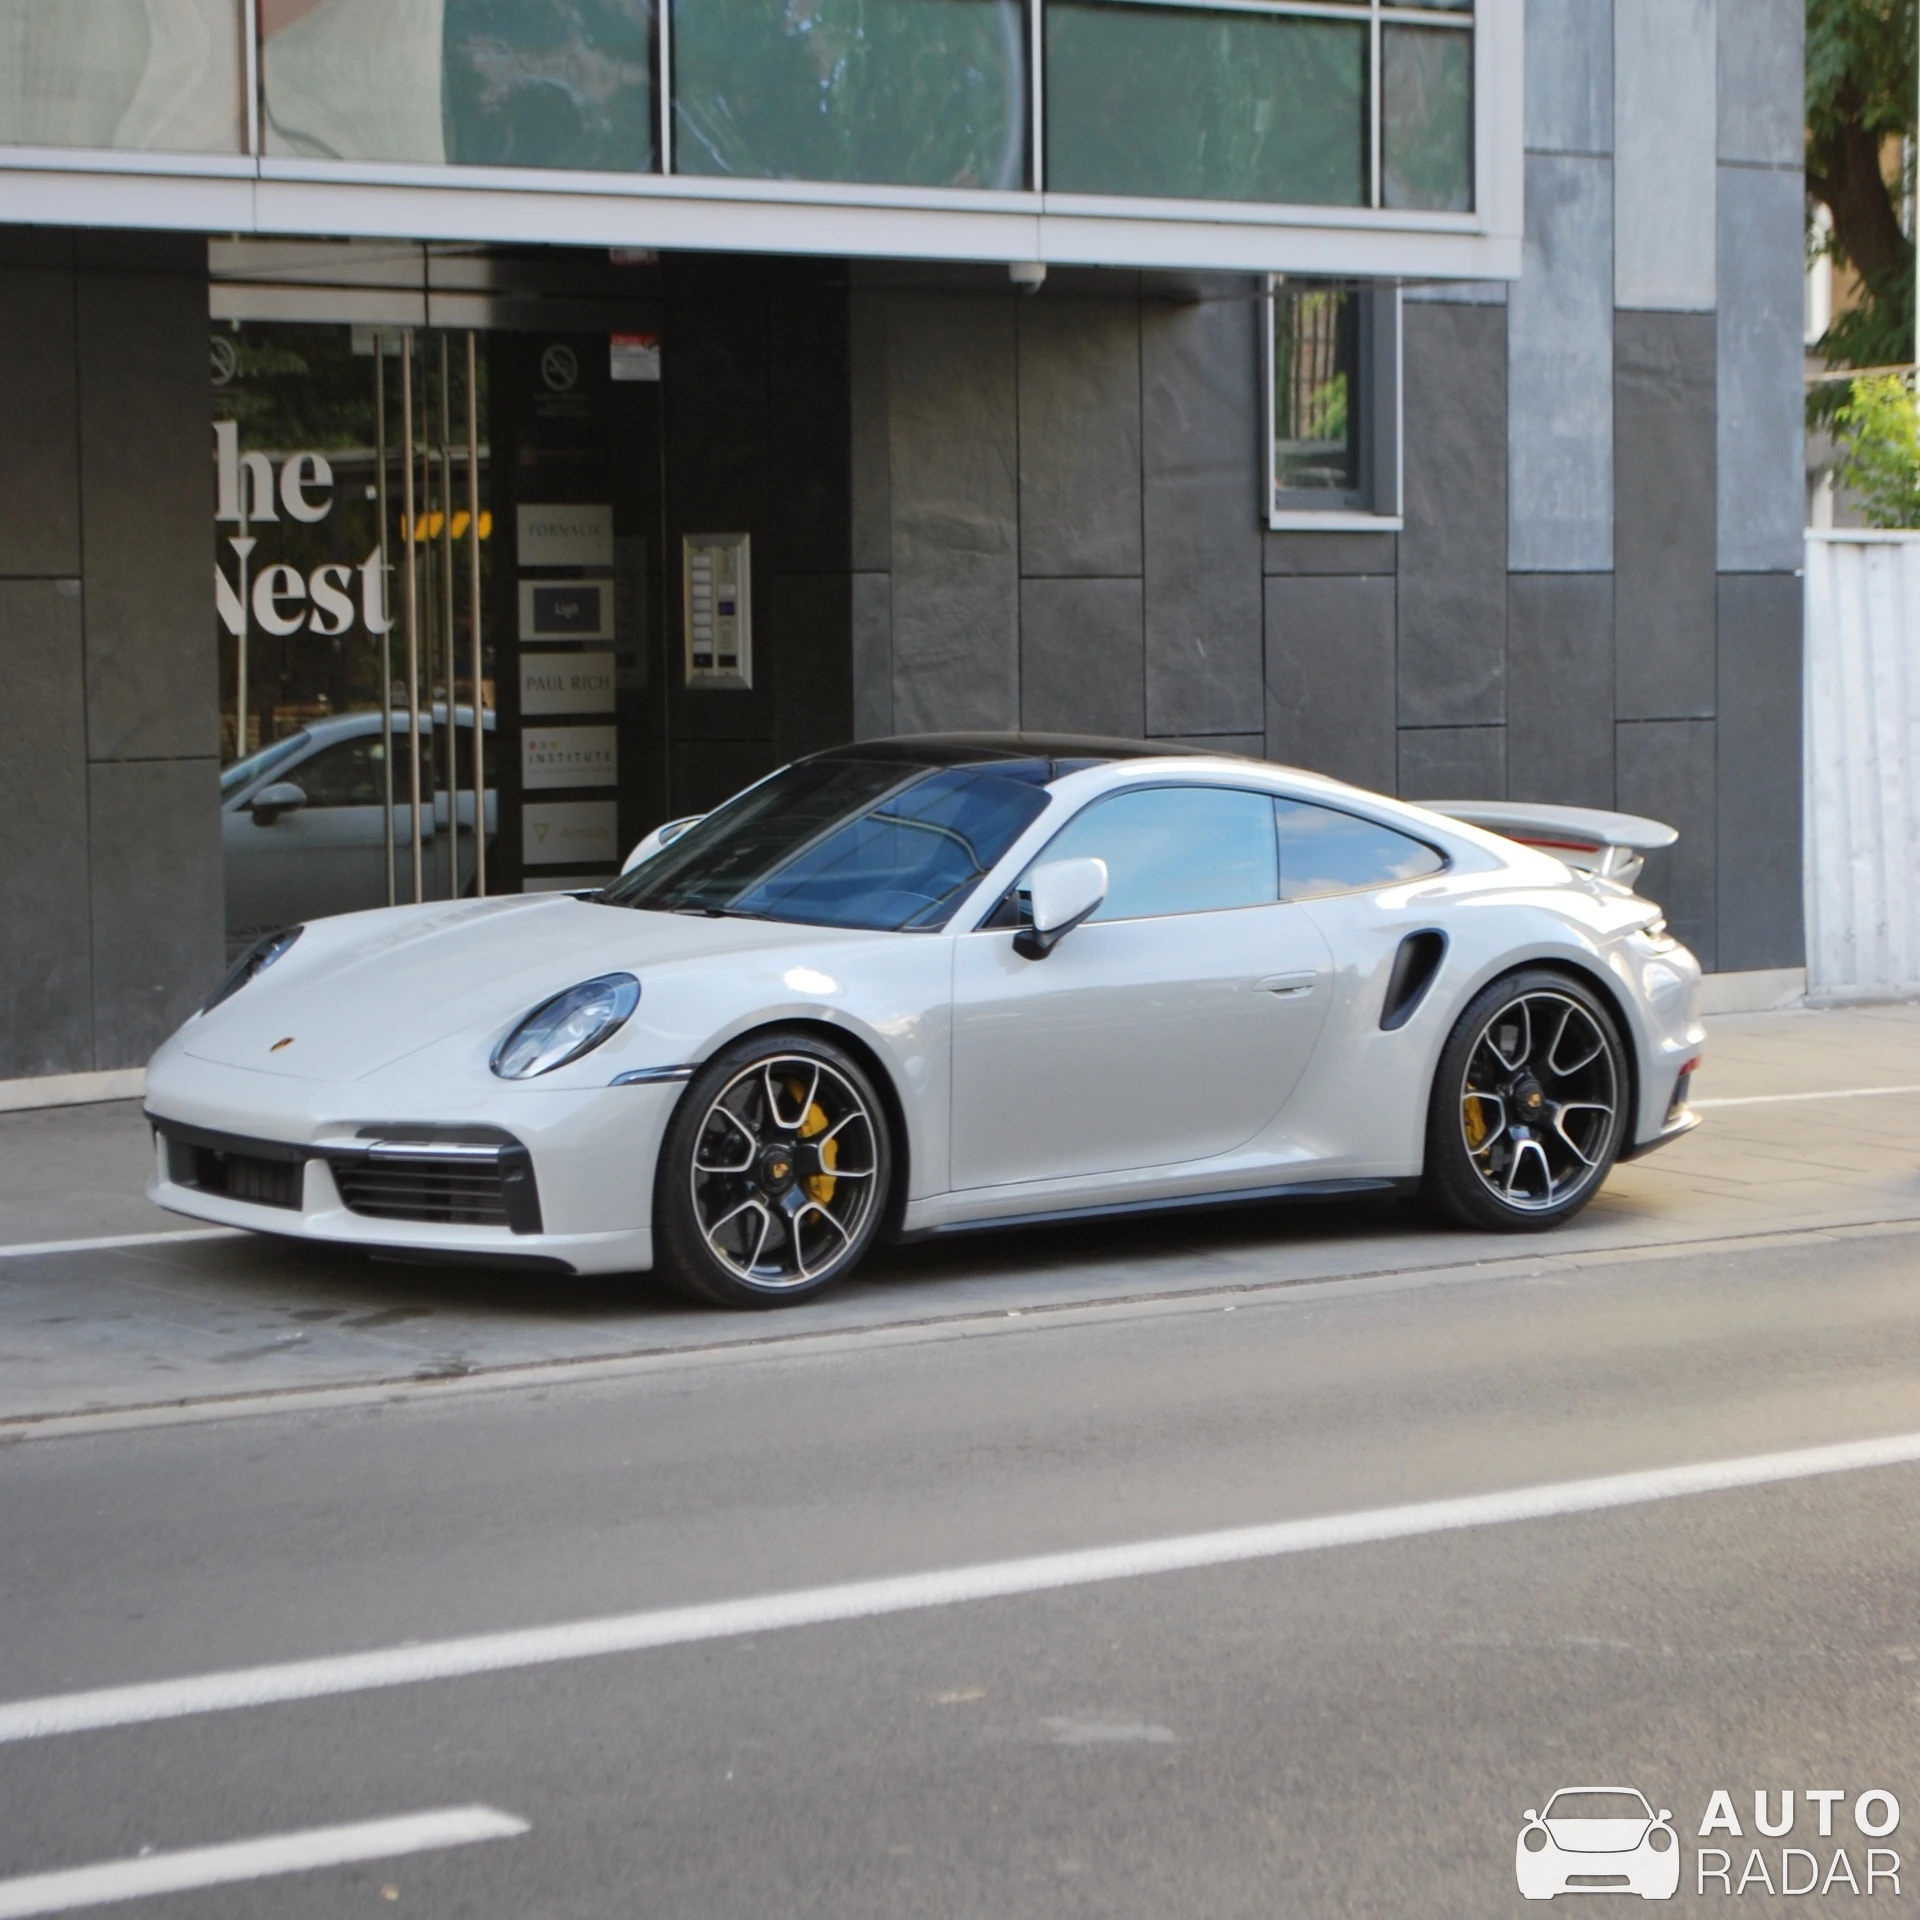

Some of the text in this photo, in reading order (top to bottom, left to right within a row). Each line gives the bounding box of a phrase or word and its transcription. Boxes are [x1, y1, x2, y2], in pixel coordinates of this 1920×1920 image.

[212, 419, 334, 523] he
[526, 675, 611, 693] PAUL RICH
[528, 751, 613, 765] INSTITUTE
